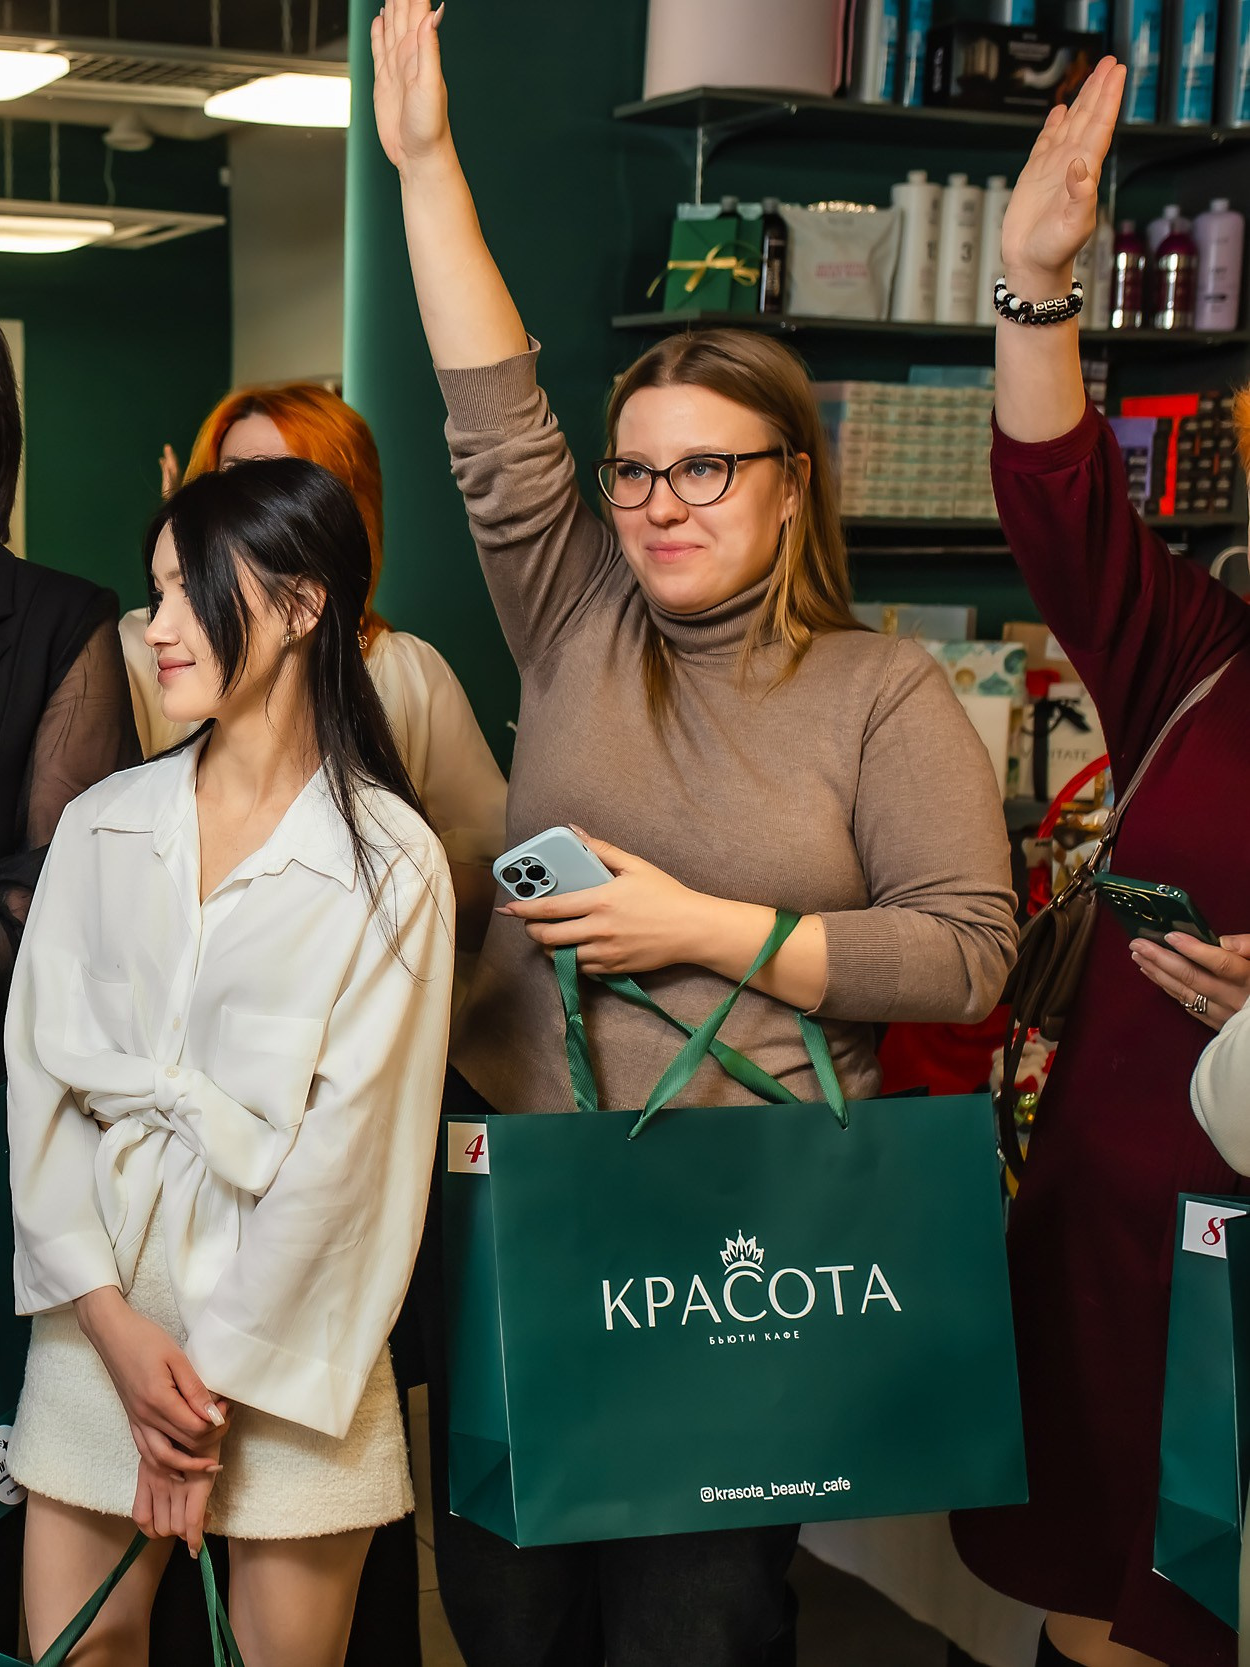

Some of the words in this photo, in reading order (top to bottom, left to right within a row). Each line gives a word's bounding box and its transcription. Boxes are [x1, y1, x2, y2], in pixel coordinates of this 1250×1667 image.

[961, 242, 973, 263] 3
[464, 1134, 485, 1163] 4
[1201, 1216, 1225, 1246] 8
[601, 1263, 902, 1331] КРАСОТА
[709, 1333, 756, 1346] БЬЮТИ
[765, 1330, 801, 1342] КАФЕ
[715, 1476, 851, 1501] krasota_beauty_cafe
